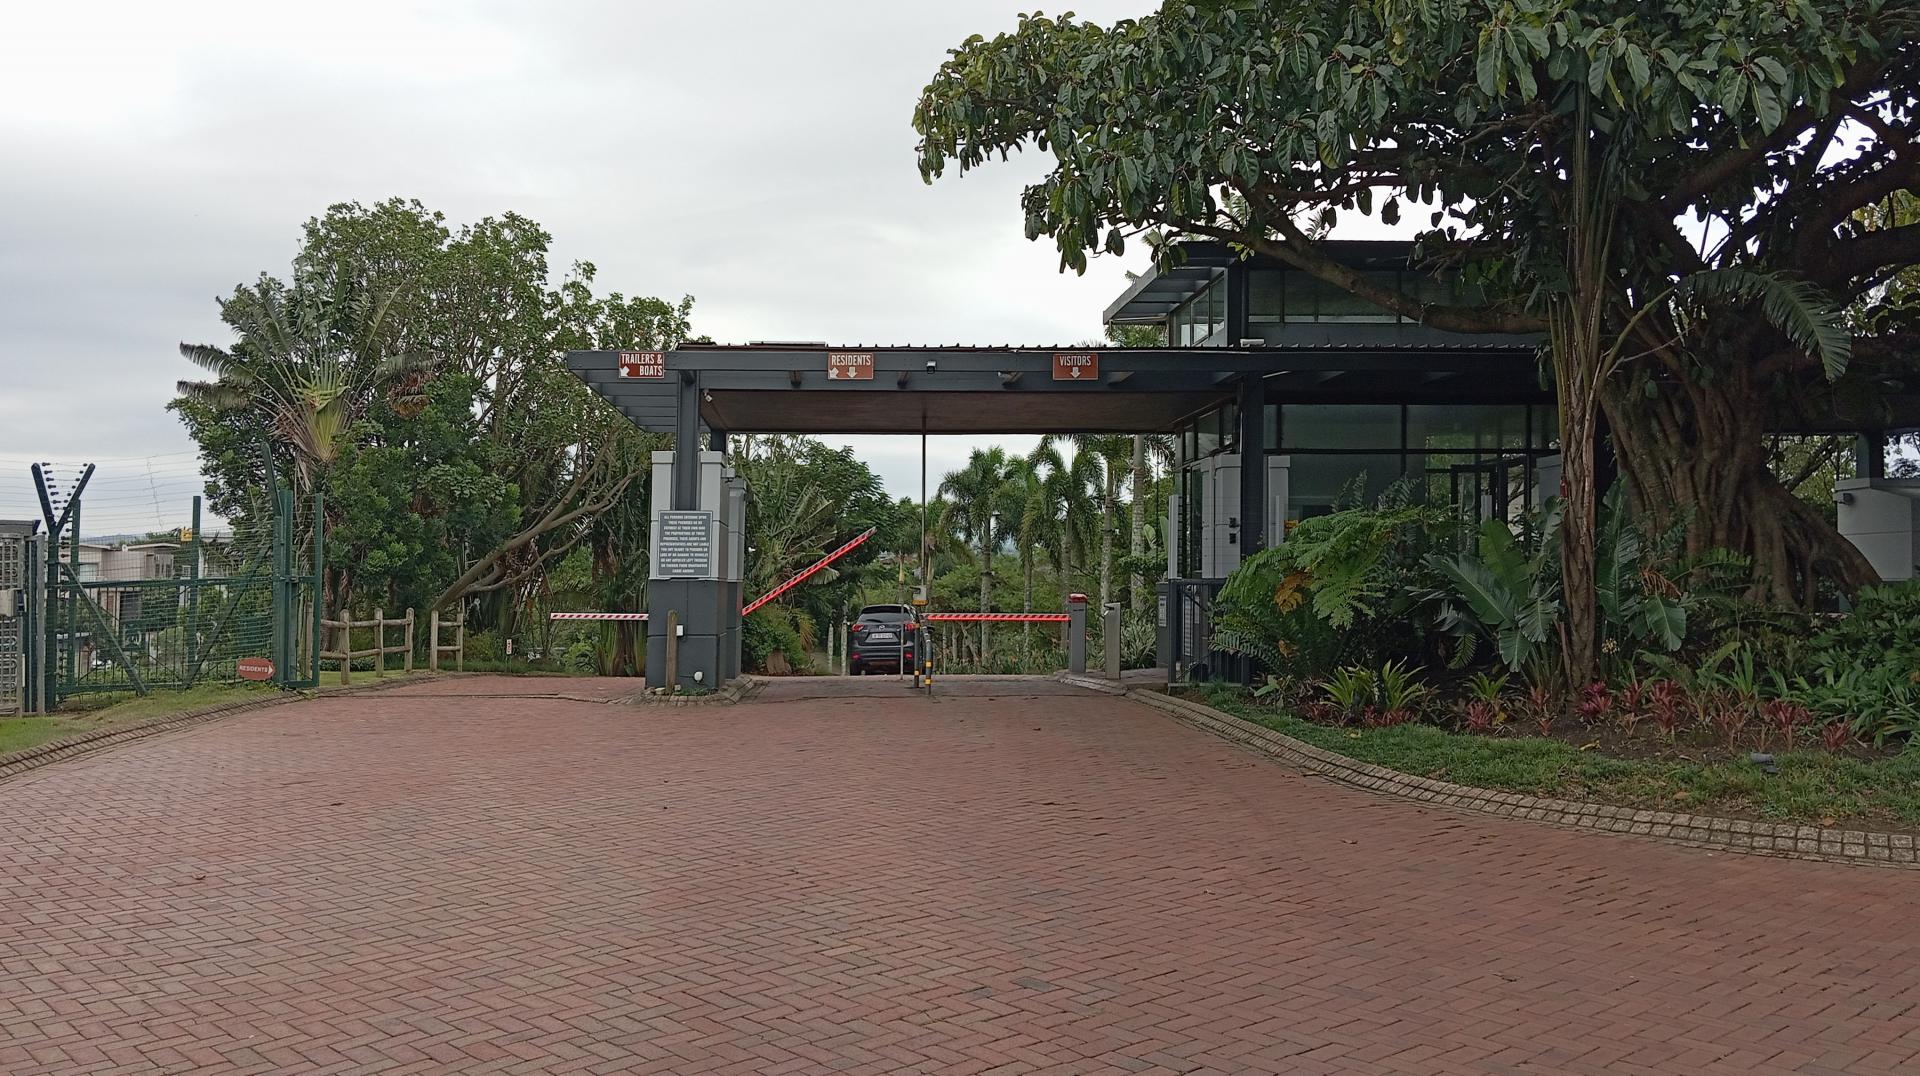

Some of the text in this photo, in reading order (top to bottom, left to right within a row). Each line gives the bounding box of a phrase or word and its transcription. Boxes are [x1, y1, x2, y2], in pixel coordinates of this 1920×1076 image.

[621, 353, 663, 364] TRAILERS &
[831, 354, 871, 366] RESIDENTS
[1059, 355, 1091, 366] VISITORS
[639, 365, 663, 376] BOATS
[239, 665, 268, 673] RESIDENTS
